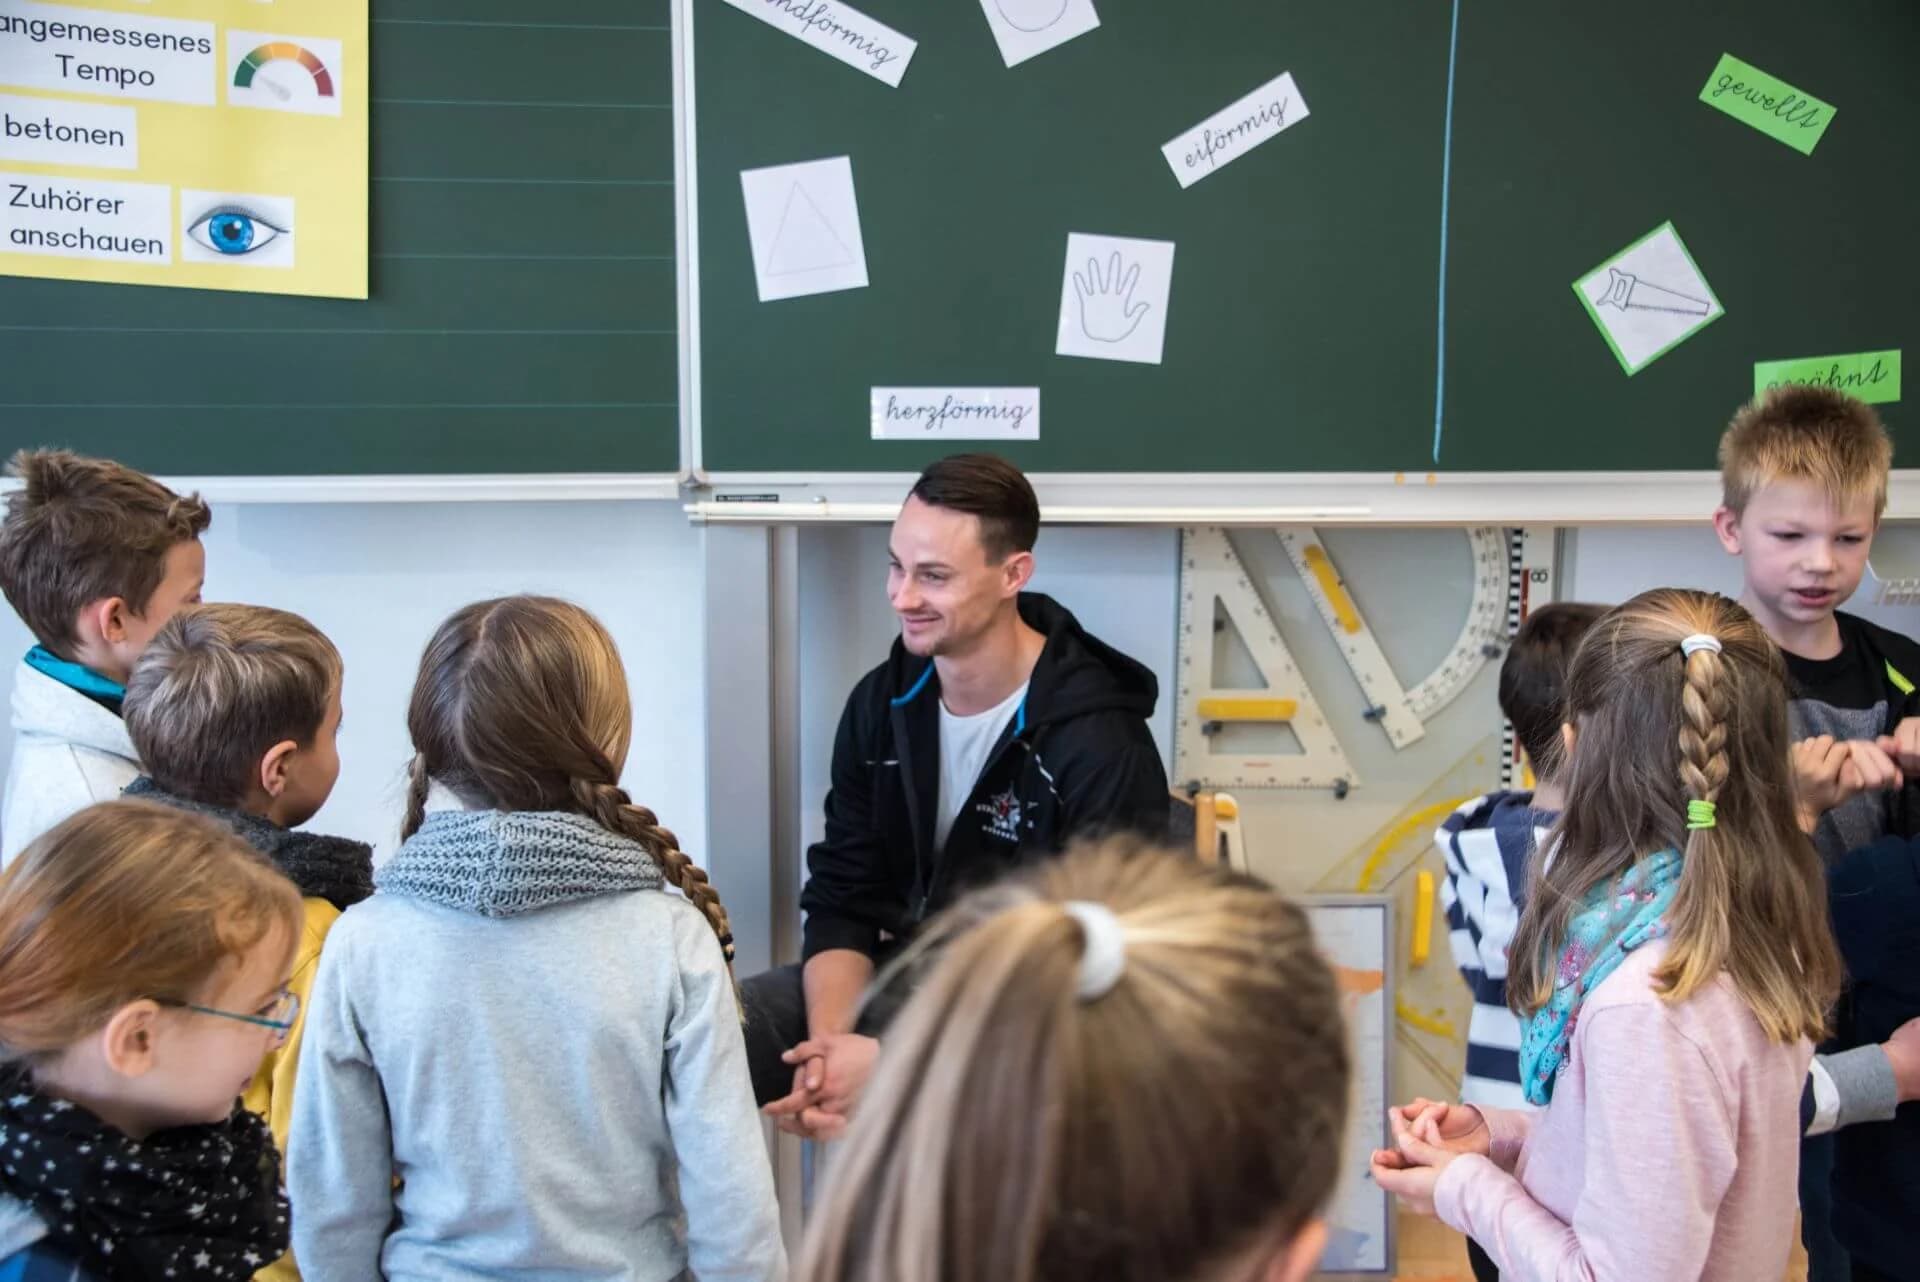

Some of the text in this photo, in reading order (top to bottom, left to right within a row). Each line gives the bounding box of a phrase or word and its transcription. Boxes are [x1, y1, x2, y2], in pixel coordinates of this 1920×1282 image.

[54, 53, 156, 90] Tempo
[1712, 74, 1820, 128] gewellt
[4, 114, 125, 147] betonen
[1185, 96, 1288, 168] eiförmig
[8, 184, 125, 215] Zuhörer
[9, 226, 164, 255] anschauen
[886, 395, 1033, 430] herzförmig
